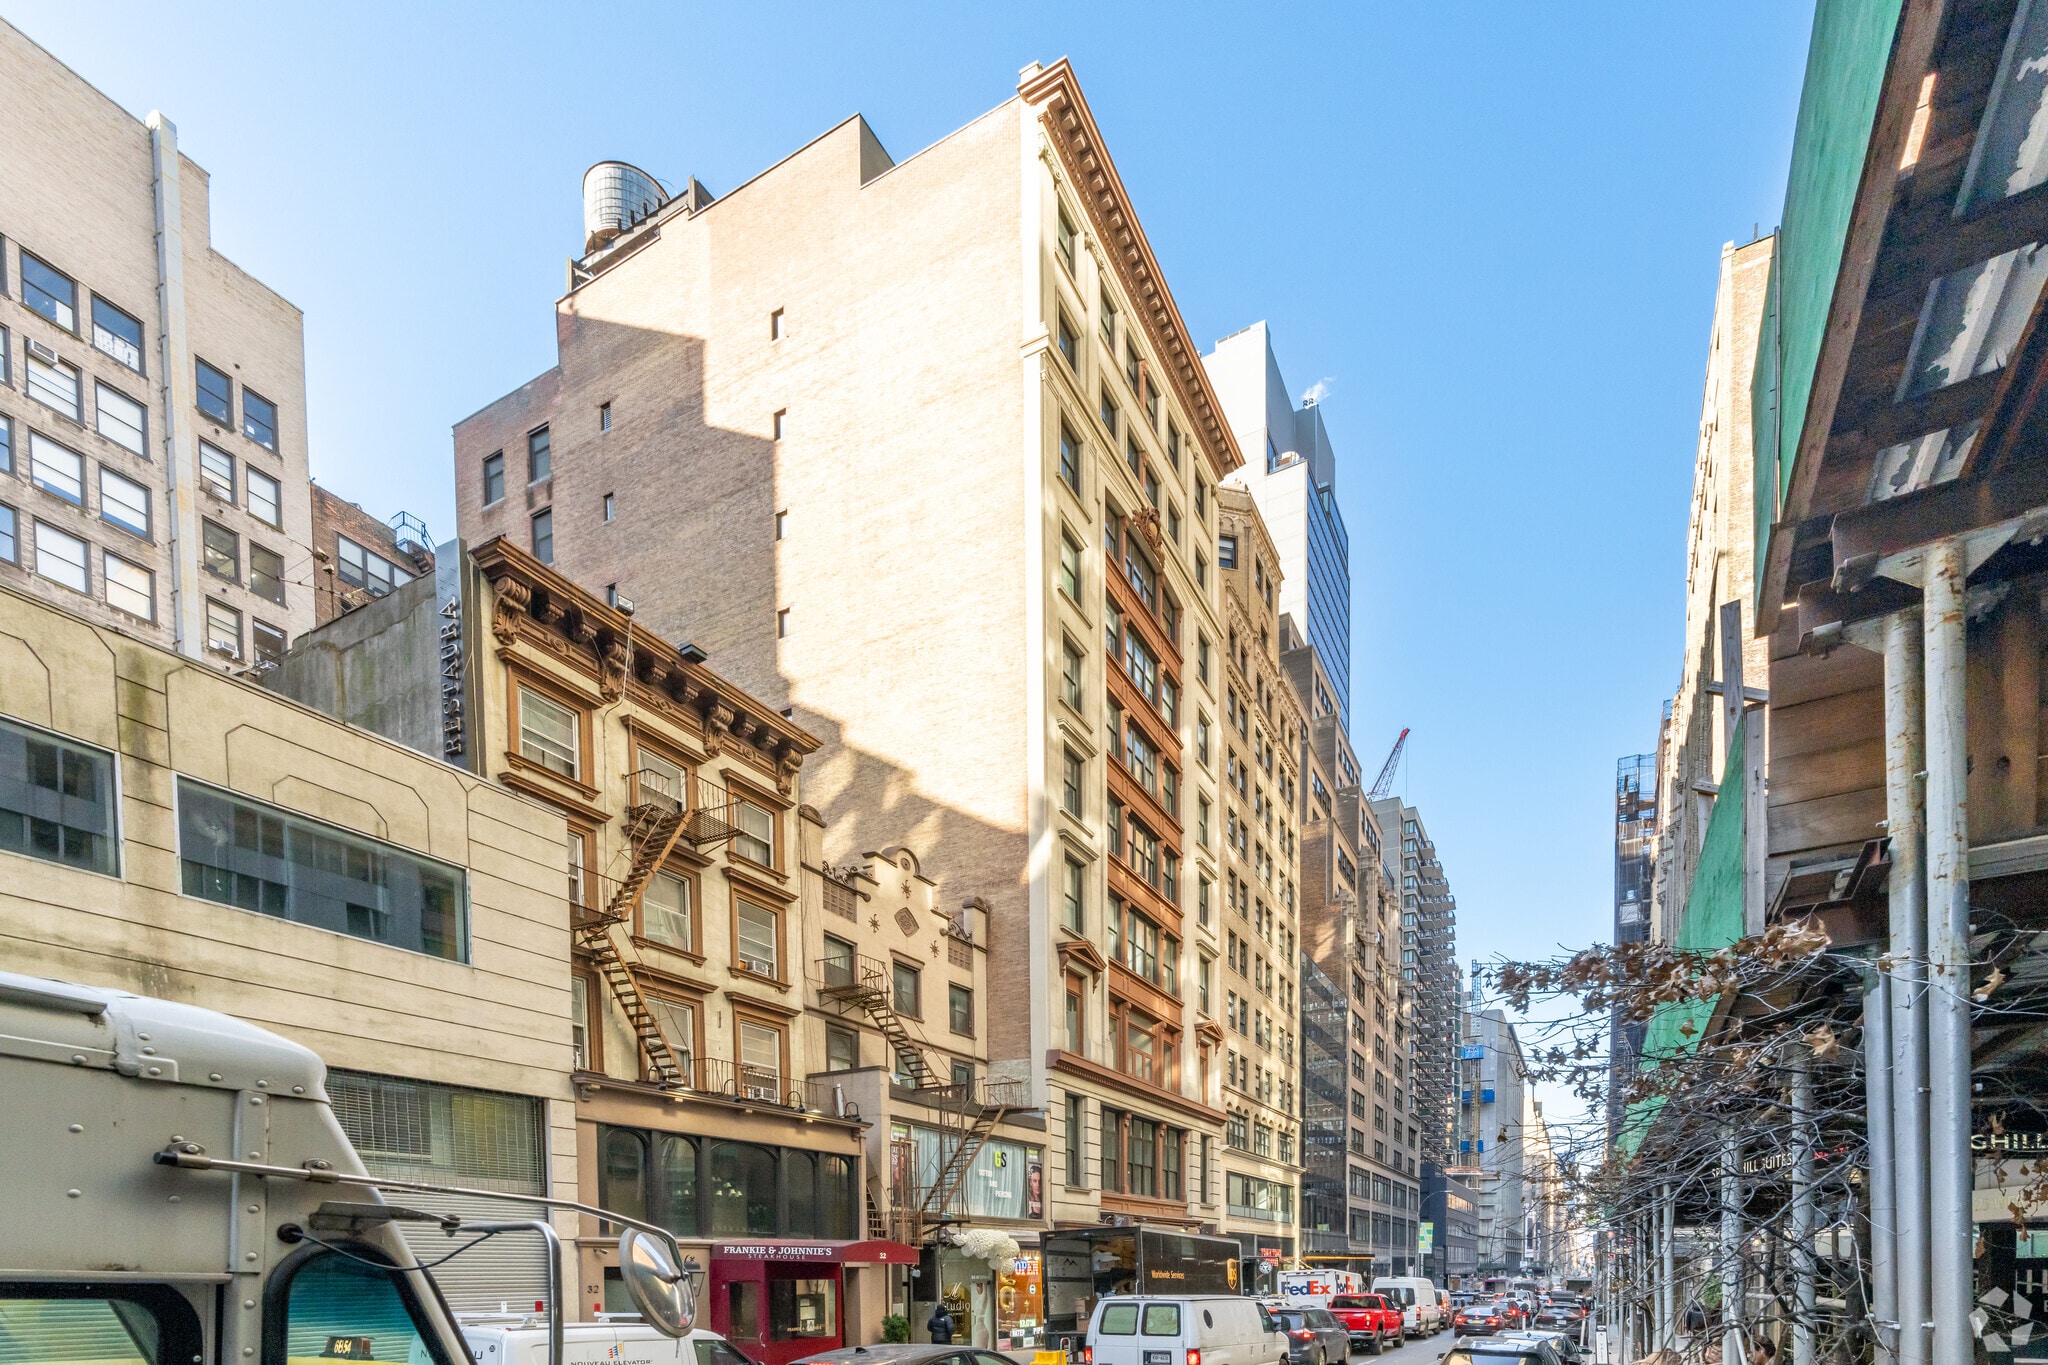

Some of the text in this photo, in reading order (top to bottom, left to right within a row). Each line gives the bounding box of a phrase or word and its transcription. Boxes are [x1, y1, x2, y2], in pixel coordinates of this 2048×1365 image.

[439, 596, 461, 754] RESTAURA
[995, 1151, 1007, 1168] GS
[1711, 1152, 1793, 1178] SPHILL SUITES
[723, 1246, 832, 1256] FRANKIE & JOHNNIE'S
[879, 1252, 887, 1260] 32
[1014, 1259, 1039, 1276] OPEN
[1151, 1269, 1185, 1280] Worldwide Services
[587, 1284, 599, 1294] 32
[1281, 1280, 1331, 1295] FedEx
